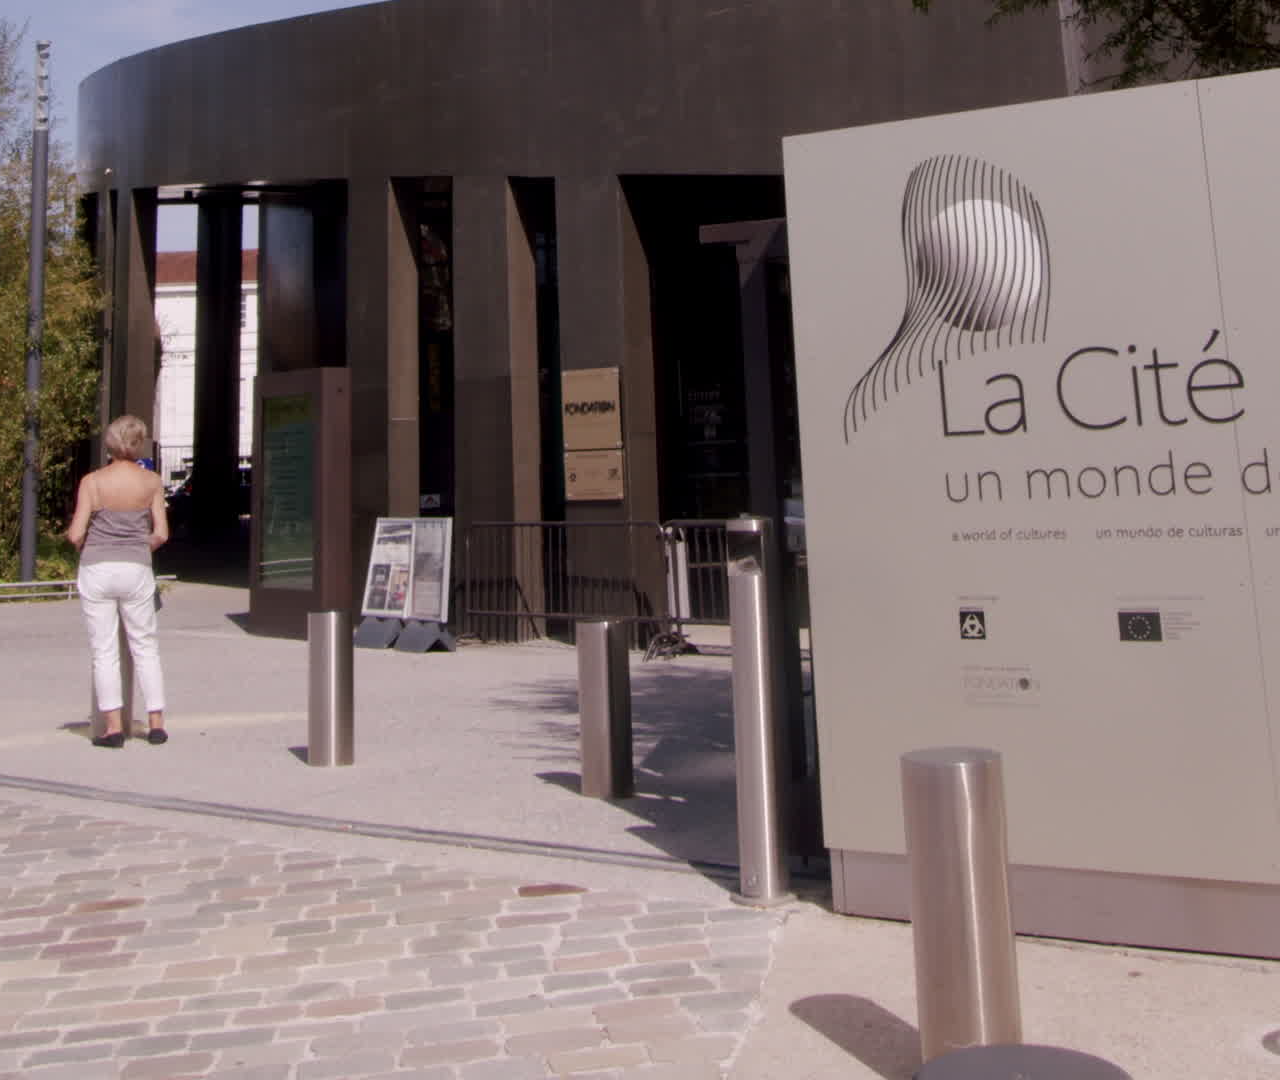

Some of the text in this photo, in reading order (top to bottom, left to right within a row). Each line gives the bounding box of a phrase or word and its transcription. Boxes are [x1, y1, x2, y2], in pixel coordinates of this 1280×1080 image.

[939, 358, 1029, 438] La
[1056, 328, 1246, 431] Cité
[945, 470, 1003, 504] un
[1025, 450, 1213, 499] monde
[961, 528, 997, 543] world
[999, 527, 1013, 542] of
[1016, 526, 1068, 541] cultures
[1095, 523, 1243, 540] un mundo de culturas
